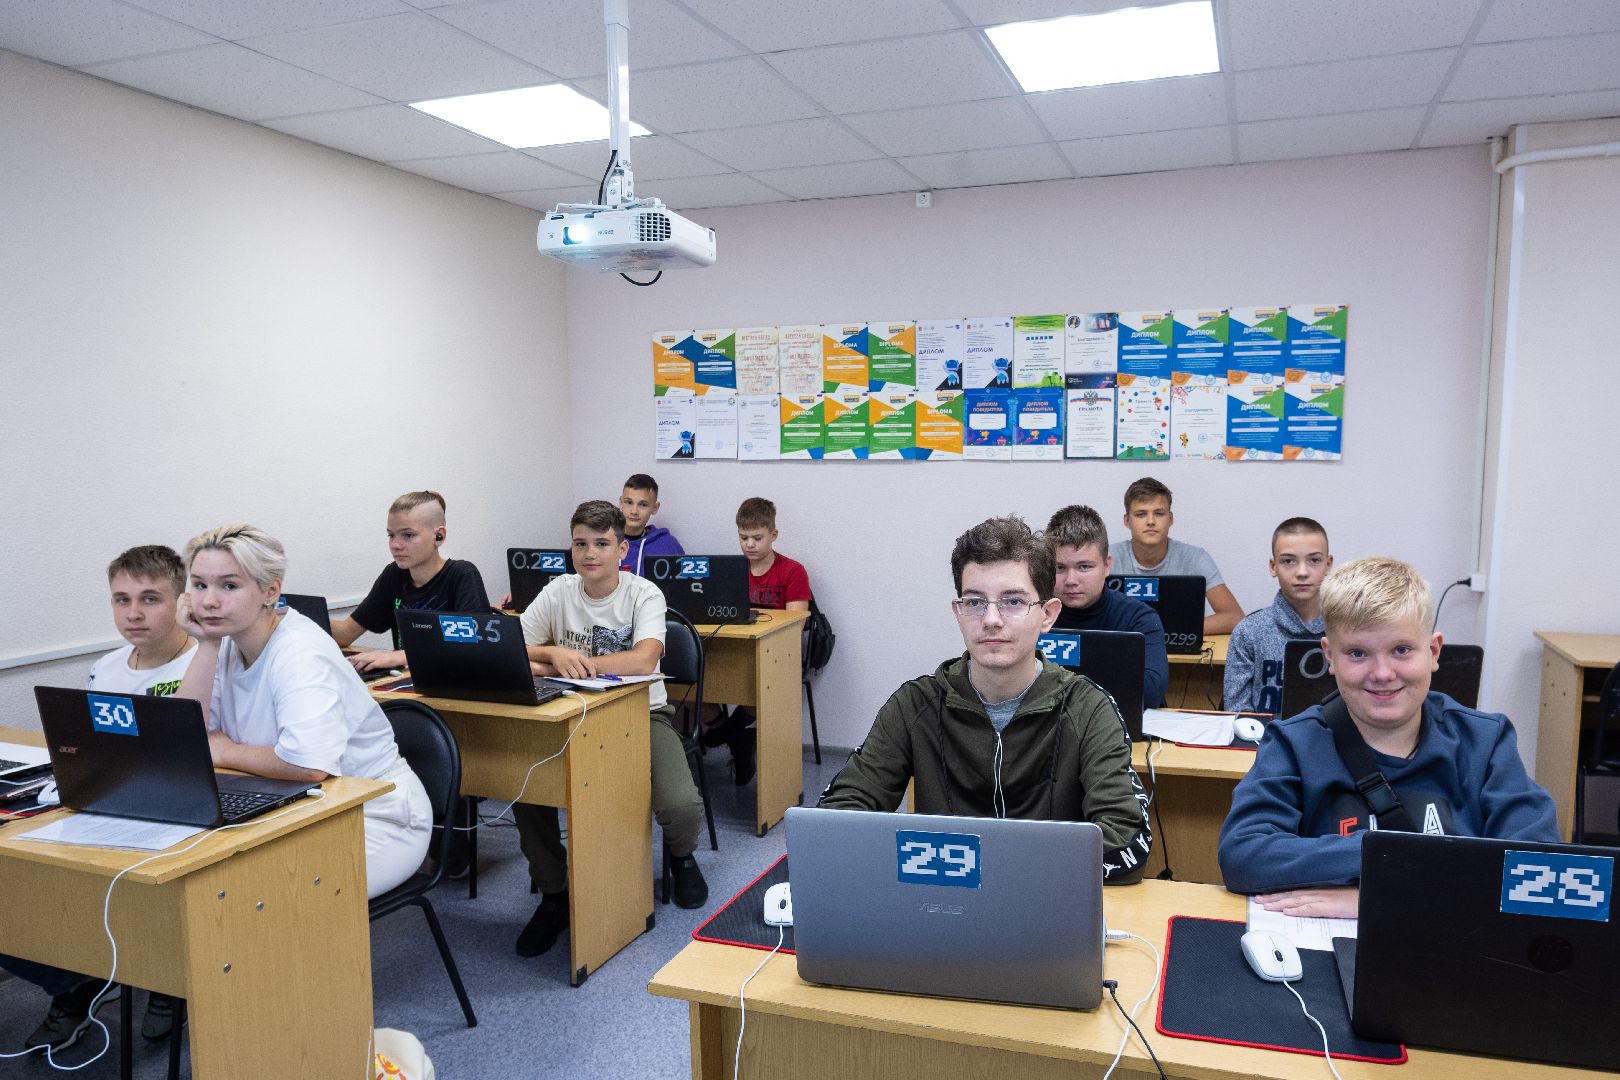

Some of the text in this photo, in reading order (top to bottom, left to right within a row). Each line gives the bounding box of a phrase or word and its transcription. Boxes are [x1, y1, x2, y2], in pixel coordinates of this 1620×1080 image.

[542, 556, 564, 569] 22
[682, 561, 708, 574] 23
[1126, 582, 1156, 597] 21
[708, 606, 738, 618] 0300
[442, 620, 475, 638] 25
[1038, 639, 1078, 660] 27
[94, 702, 134, 728] 30
[58, 745, 78, 754] acer
[900, 842, 976, 877] 29
[1508, 864, 1604, 907] 28
[919, 902, 965, 915] ASUS
